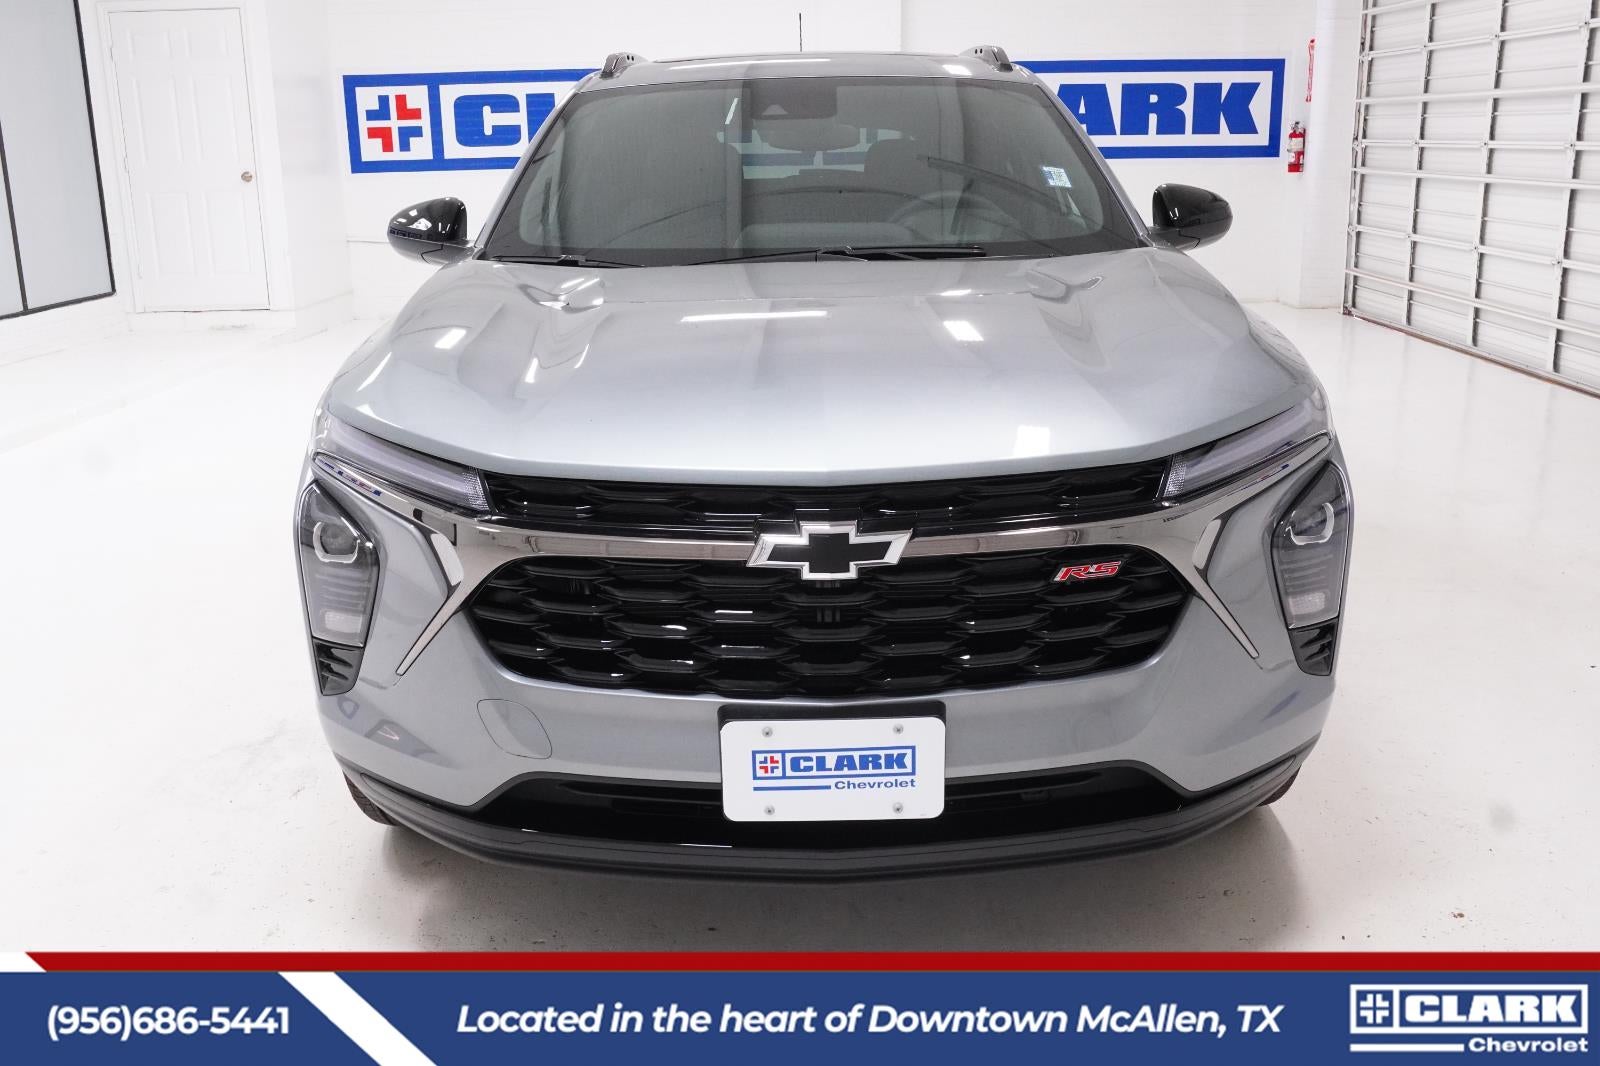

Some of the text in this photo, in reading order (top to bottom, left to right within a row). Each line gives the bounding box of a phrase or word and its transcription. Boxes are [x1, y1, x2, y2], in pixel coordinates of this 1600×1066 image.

[1056, 82, 1260, 136] ARK
[1053, 560, 1122, 582] RS
[790, 752, 908, 773] CLARK
[834, 778, 916, 790] Chevrolet
